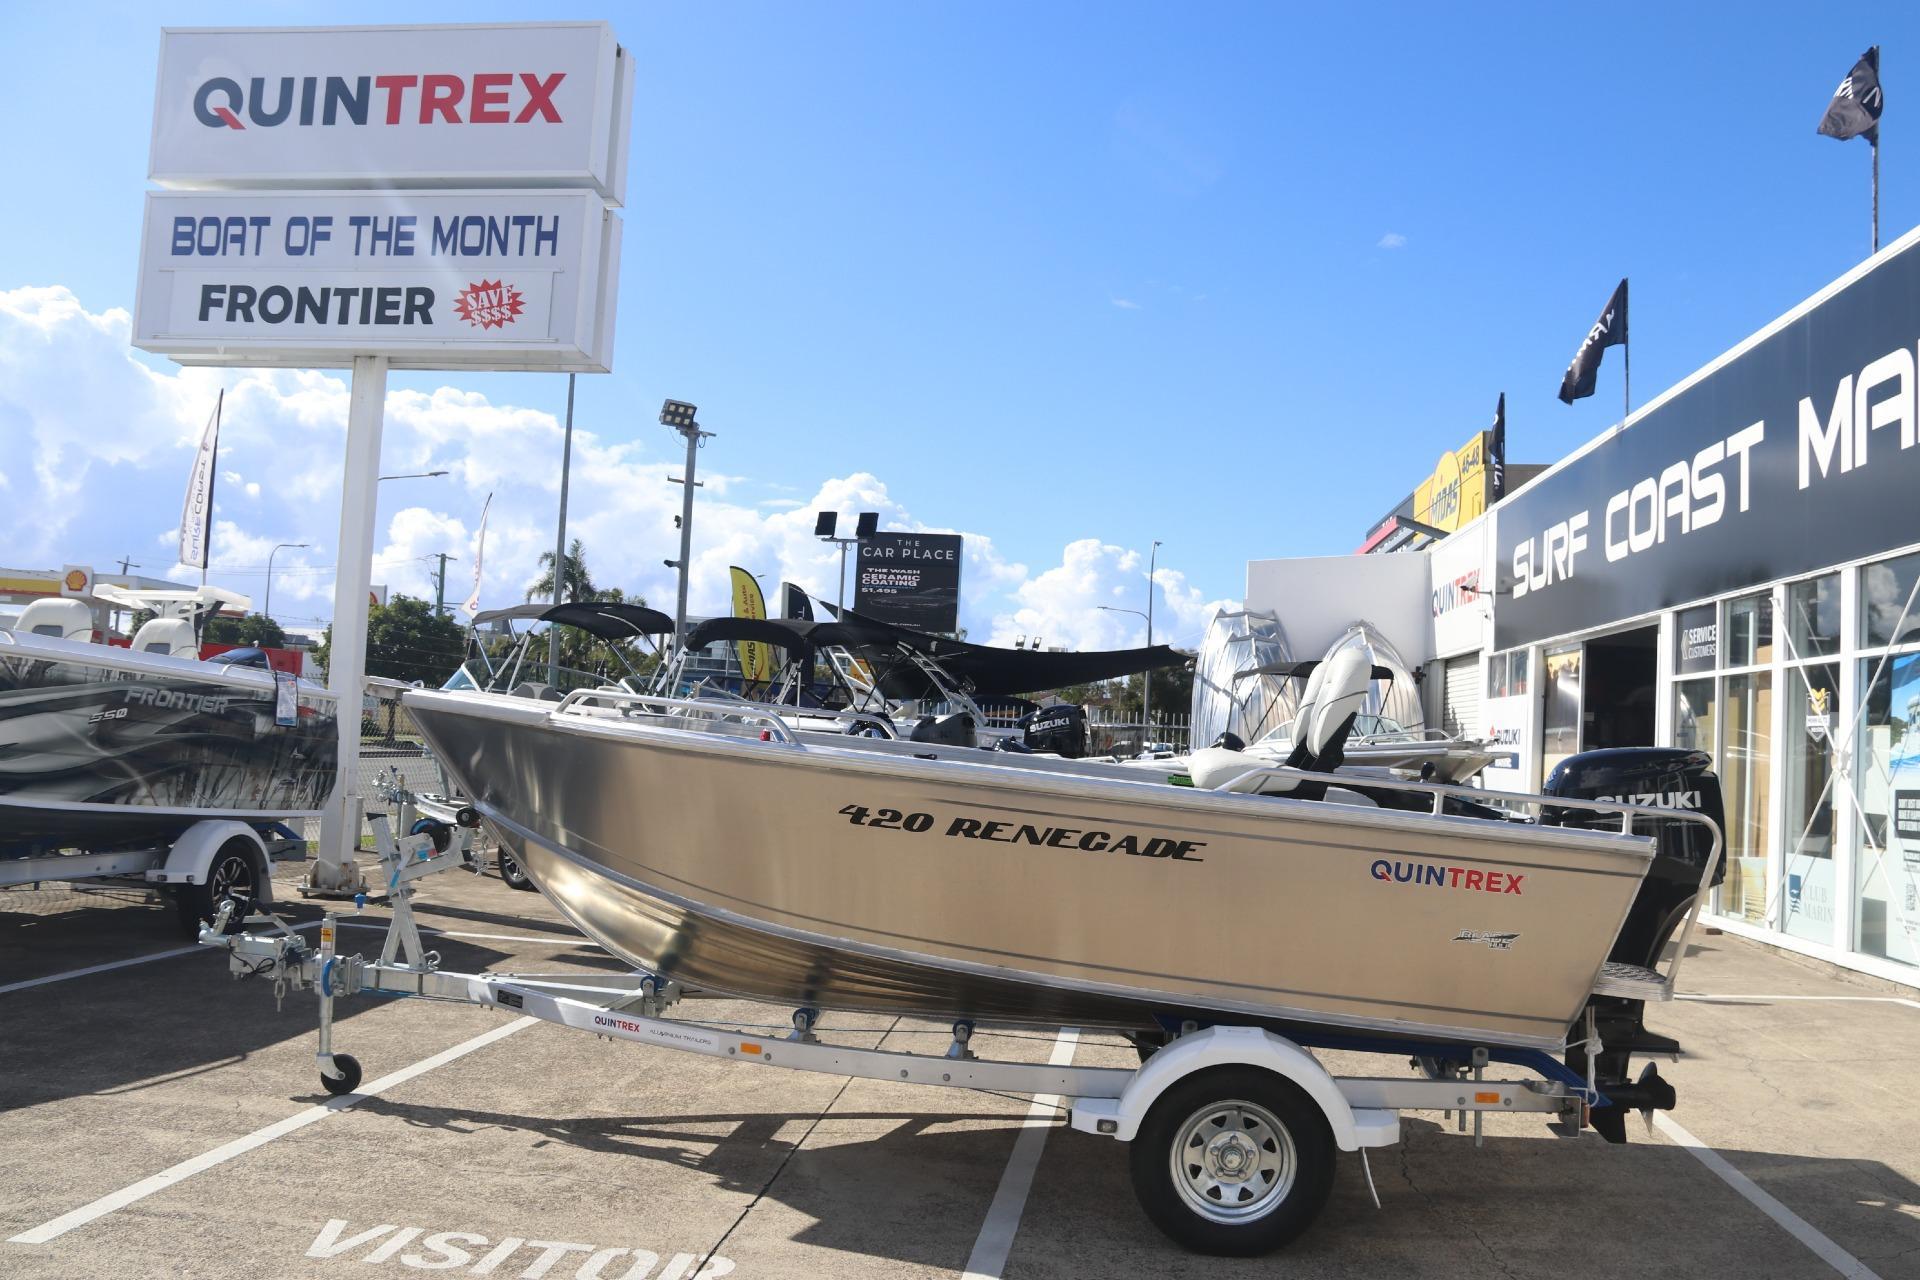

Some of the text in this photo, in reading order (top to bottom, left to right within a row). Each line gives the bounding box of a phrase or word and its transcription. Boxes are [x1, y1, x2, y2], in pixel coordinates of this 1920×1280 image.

[194, 72, 567, 130] QUINTREX
[171, 214, 559, 257] BOAT OF THE MONTH
[198, 283, 435, 325] FRONTIER
[466, 286, 513, 311] SAVE
[471, 304, 512, 325] $$$$
[1512, 339, 1920, 600] SURF COAST MA
[862, 547, 954, 560] CAR PLACE
[896, 539, 921, 547] THE
[862, 573, 921, 581] CERAMIC
[862, 578, 917, 587] COATING
[1688, 624, 1717, 645] SERVICE
[124, 686, 229, 715] FRONTIER
[87, 707, 129, 725] 550
[1029, 717, 1070, 733] SUZUKI
[837, 804, 1208, 863] 420 RENEGADE
[1370, 859, 1524, 895] QUINTREX
[594, 1015, 641, 1033] QUINTREX
